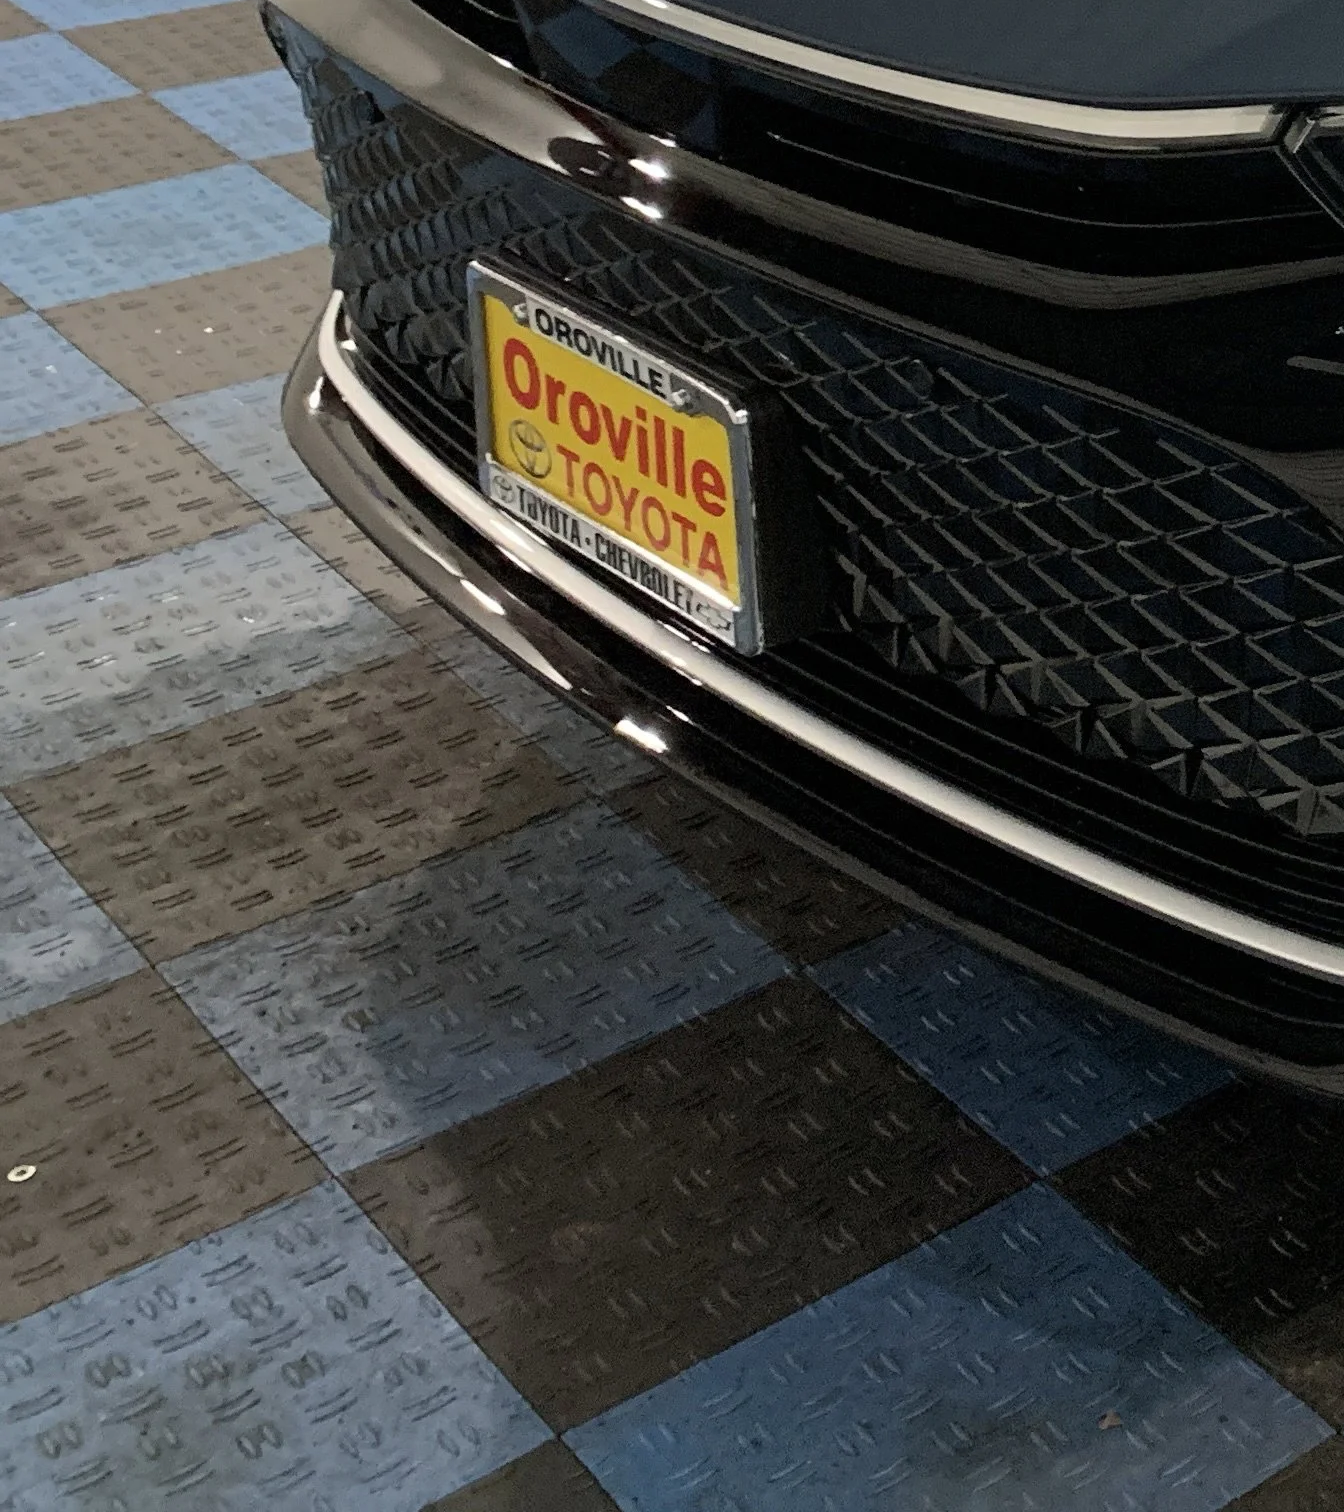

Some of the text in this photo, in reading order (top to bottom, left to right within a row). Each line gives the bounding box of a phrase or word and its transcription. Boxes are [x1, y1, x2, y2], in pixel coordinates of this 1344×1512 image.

[535, 306, 666, 398] OROVILLE
[503, 337, 727, 518] Oroville
[556, 443, 729, 589] TOYOTA
